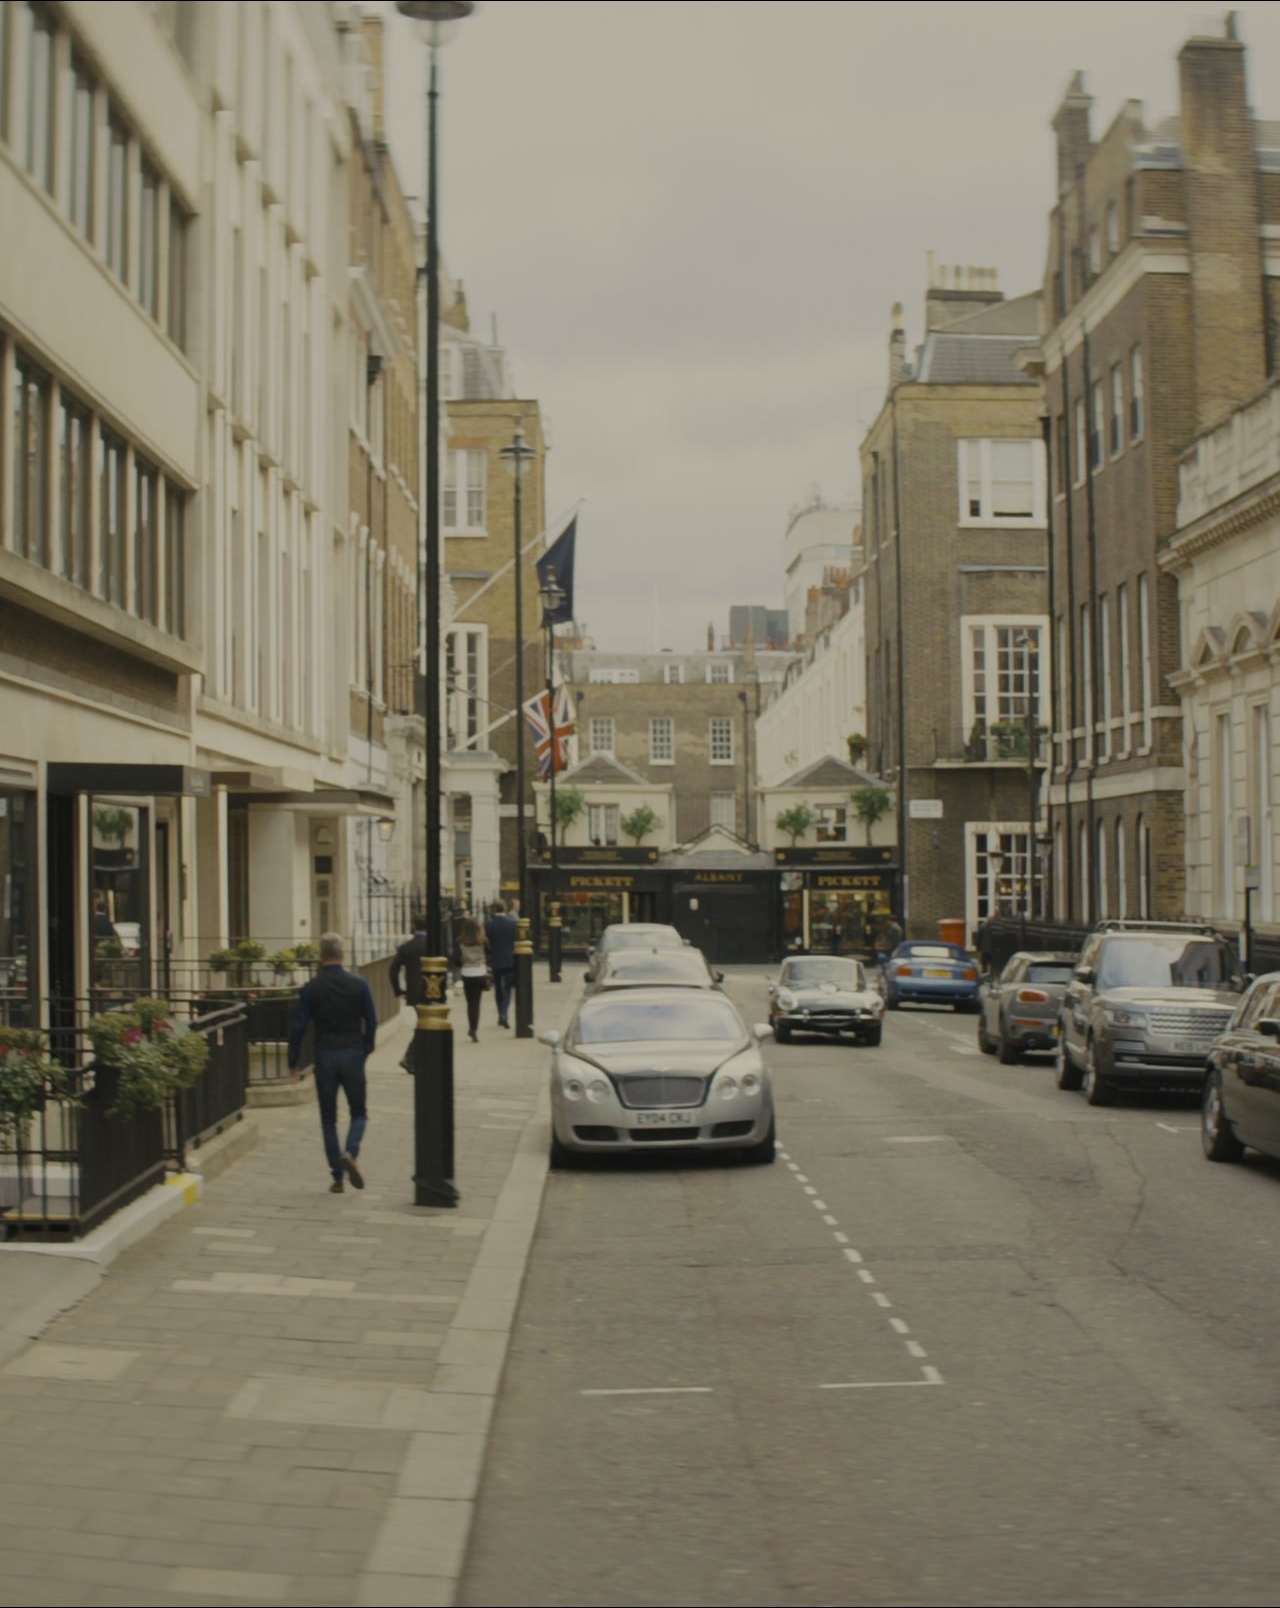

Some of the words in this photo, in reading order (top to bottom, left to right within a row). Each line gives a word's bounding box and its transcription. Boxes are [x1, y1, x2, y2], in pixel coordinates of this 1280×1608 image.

[570, 876, 634, 887] PICKETT
[694, 871, 743, 882] ALBANY
[818, 876, 881, 887] PICKETT
